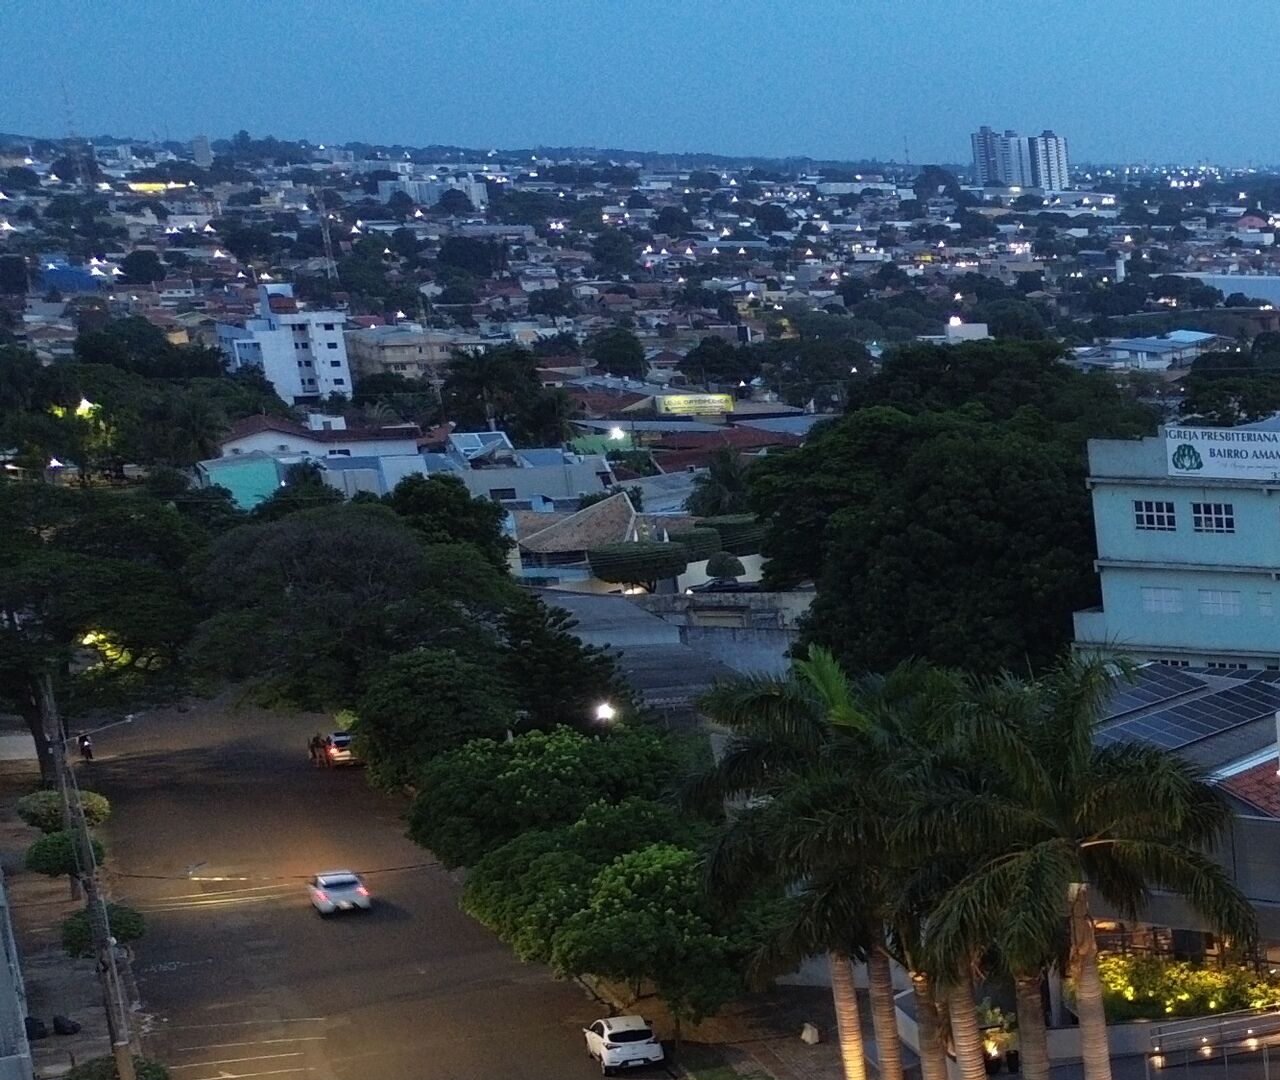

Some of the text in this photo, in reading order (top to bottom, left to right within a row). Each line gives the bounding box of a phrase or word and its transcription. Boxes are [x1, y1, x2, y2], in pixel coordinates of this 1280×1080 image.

[1165, 429, 1199, 442] IGREJA
[1201, 431, 1278, 444] PRESBITERIANA
[1209, 448, 1249, 460] BAIRRO
